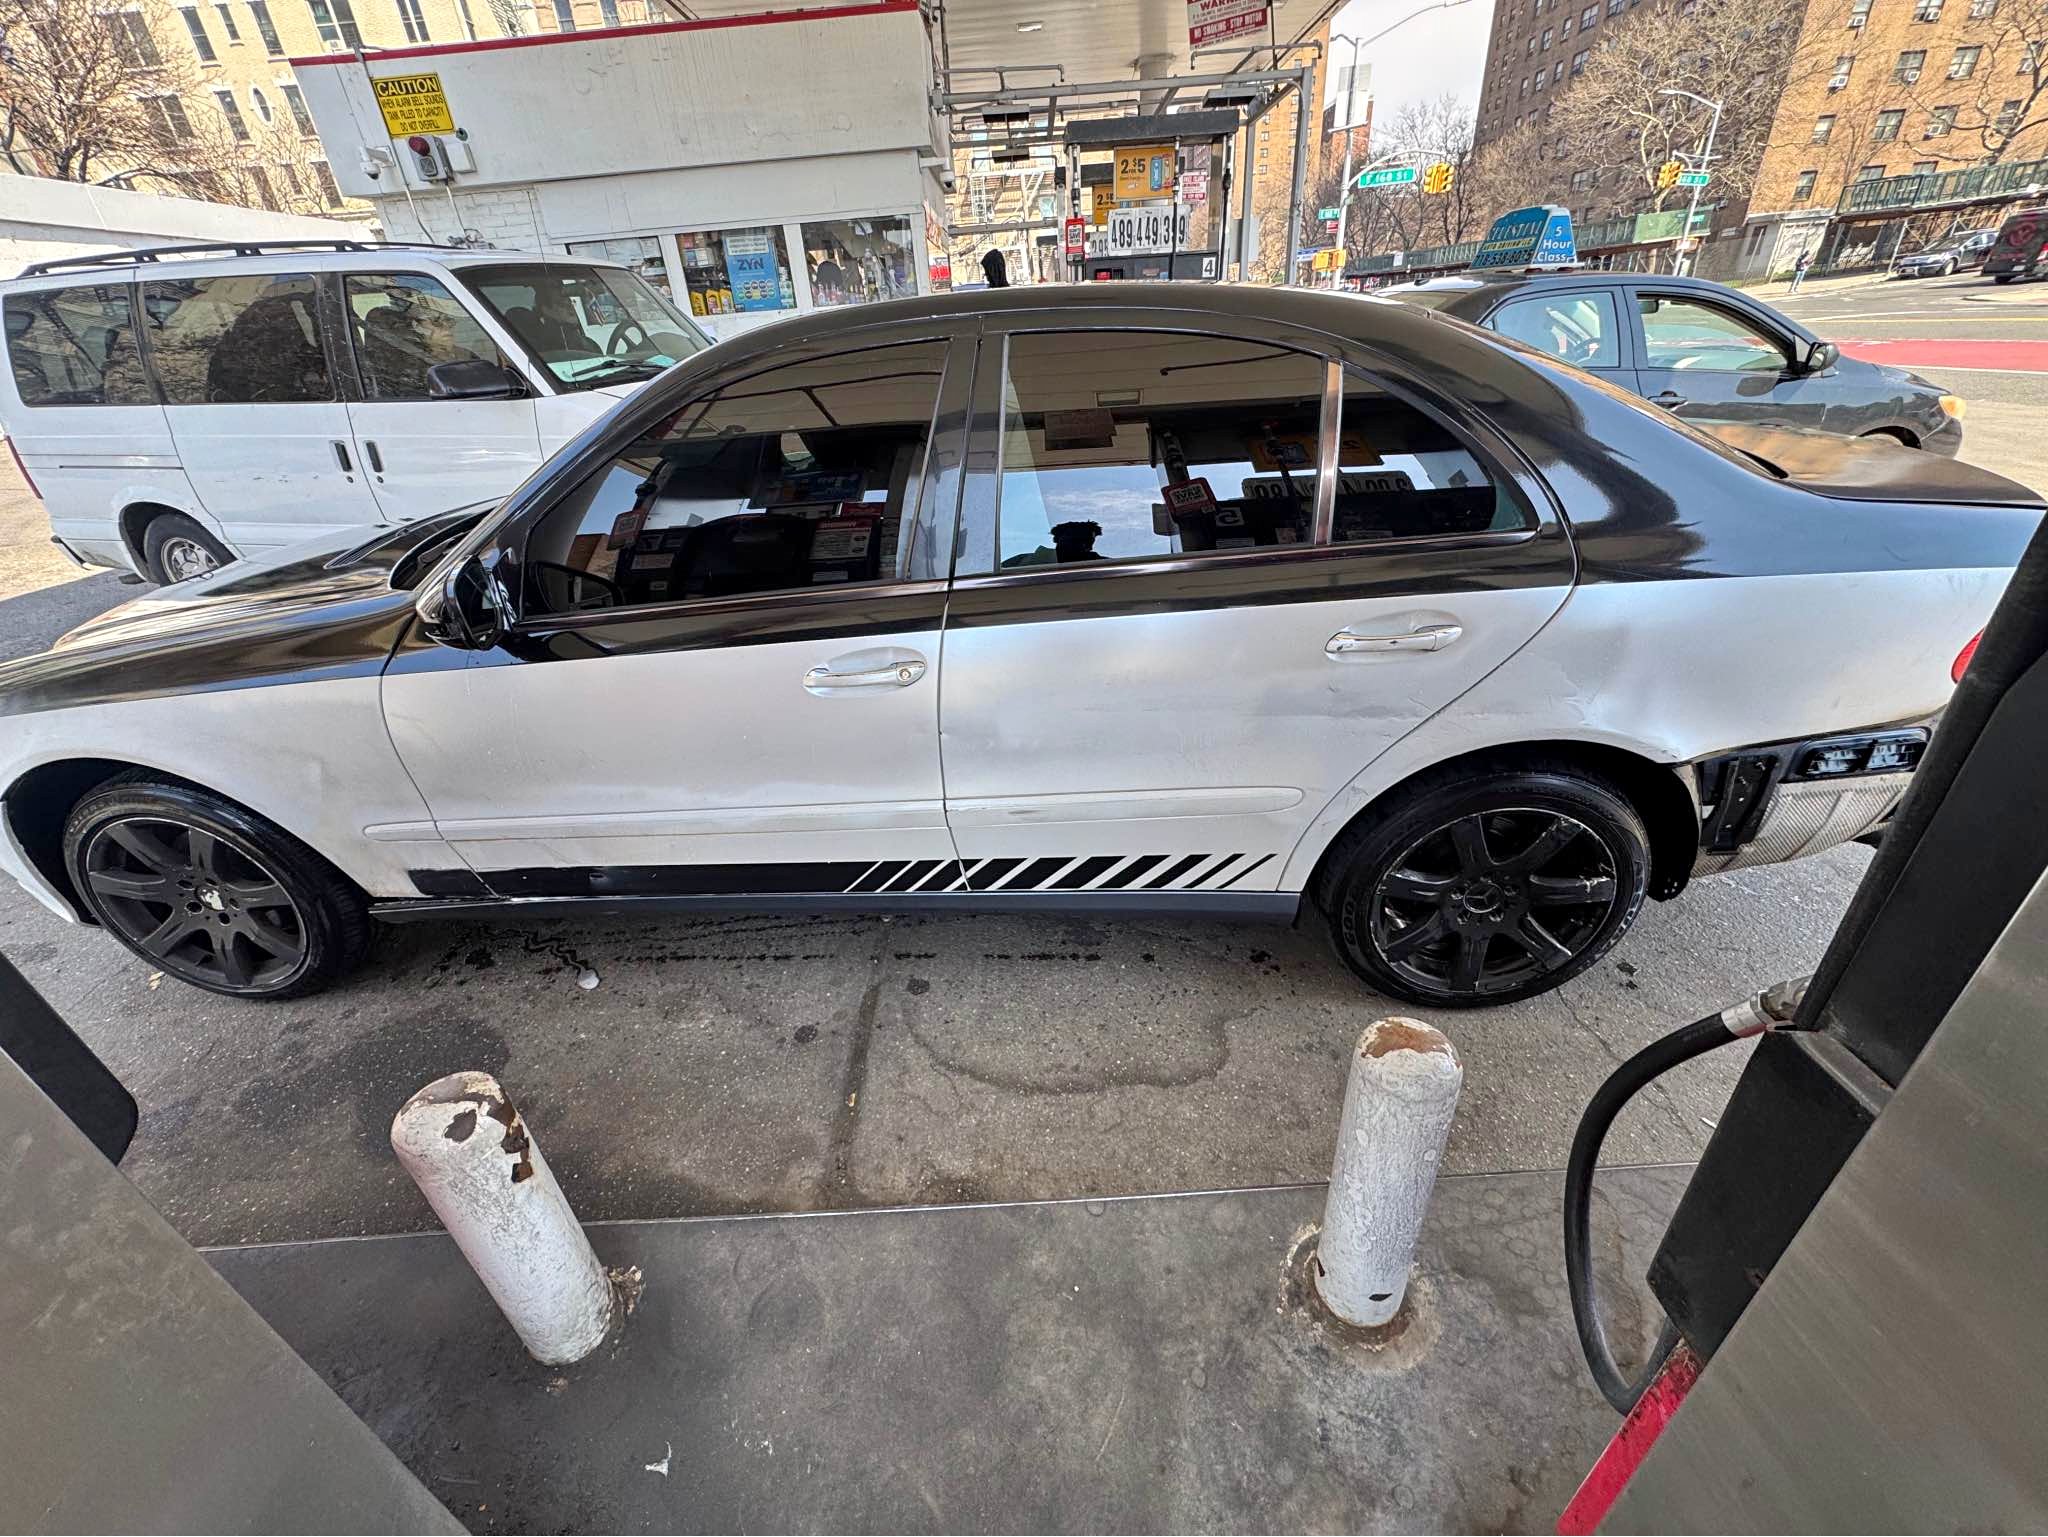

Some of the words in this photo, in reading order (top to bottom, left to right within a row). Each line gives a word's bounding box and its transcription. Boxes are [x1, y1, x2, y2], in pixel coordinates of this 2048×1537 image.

[1203, 20, 1227, 36] SMOKING
[377, 78, 438, 96] CAUTION
[395, 96, 411, 107] ALARM
[411, 95, 424, 106] BELL
[424, 93, 444, 105] SOUNDS
[399, 109, 416, 120] FILLED
[415, 108, 423, 118] TO
[422, 106, 444, 117] CAPACITY
[400, 122, 409, 132] DO
[408, 120, 417, 131] NOT
[418, 119, 440, 129] OVERFILL
[1121, 159, 1129, 174] 2
[1133, 157, 1146, 174] $5
[1111, 219, 1133, 249] 489
[1136, 216, 1159, 246] 449
[1554, 225, 1563, 237] 5
[1542, 239, 1572, 250] Hour
[737, 257, 765, 271] ZYN
[1537, 251, 1568, 263] Class
[1203, 259, 1214, 276] 4
